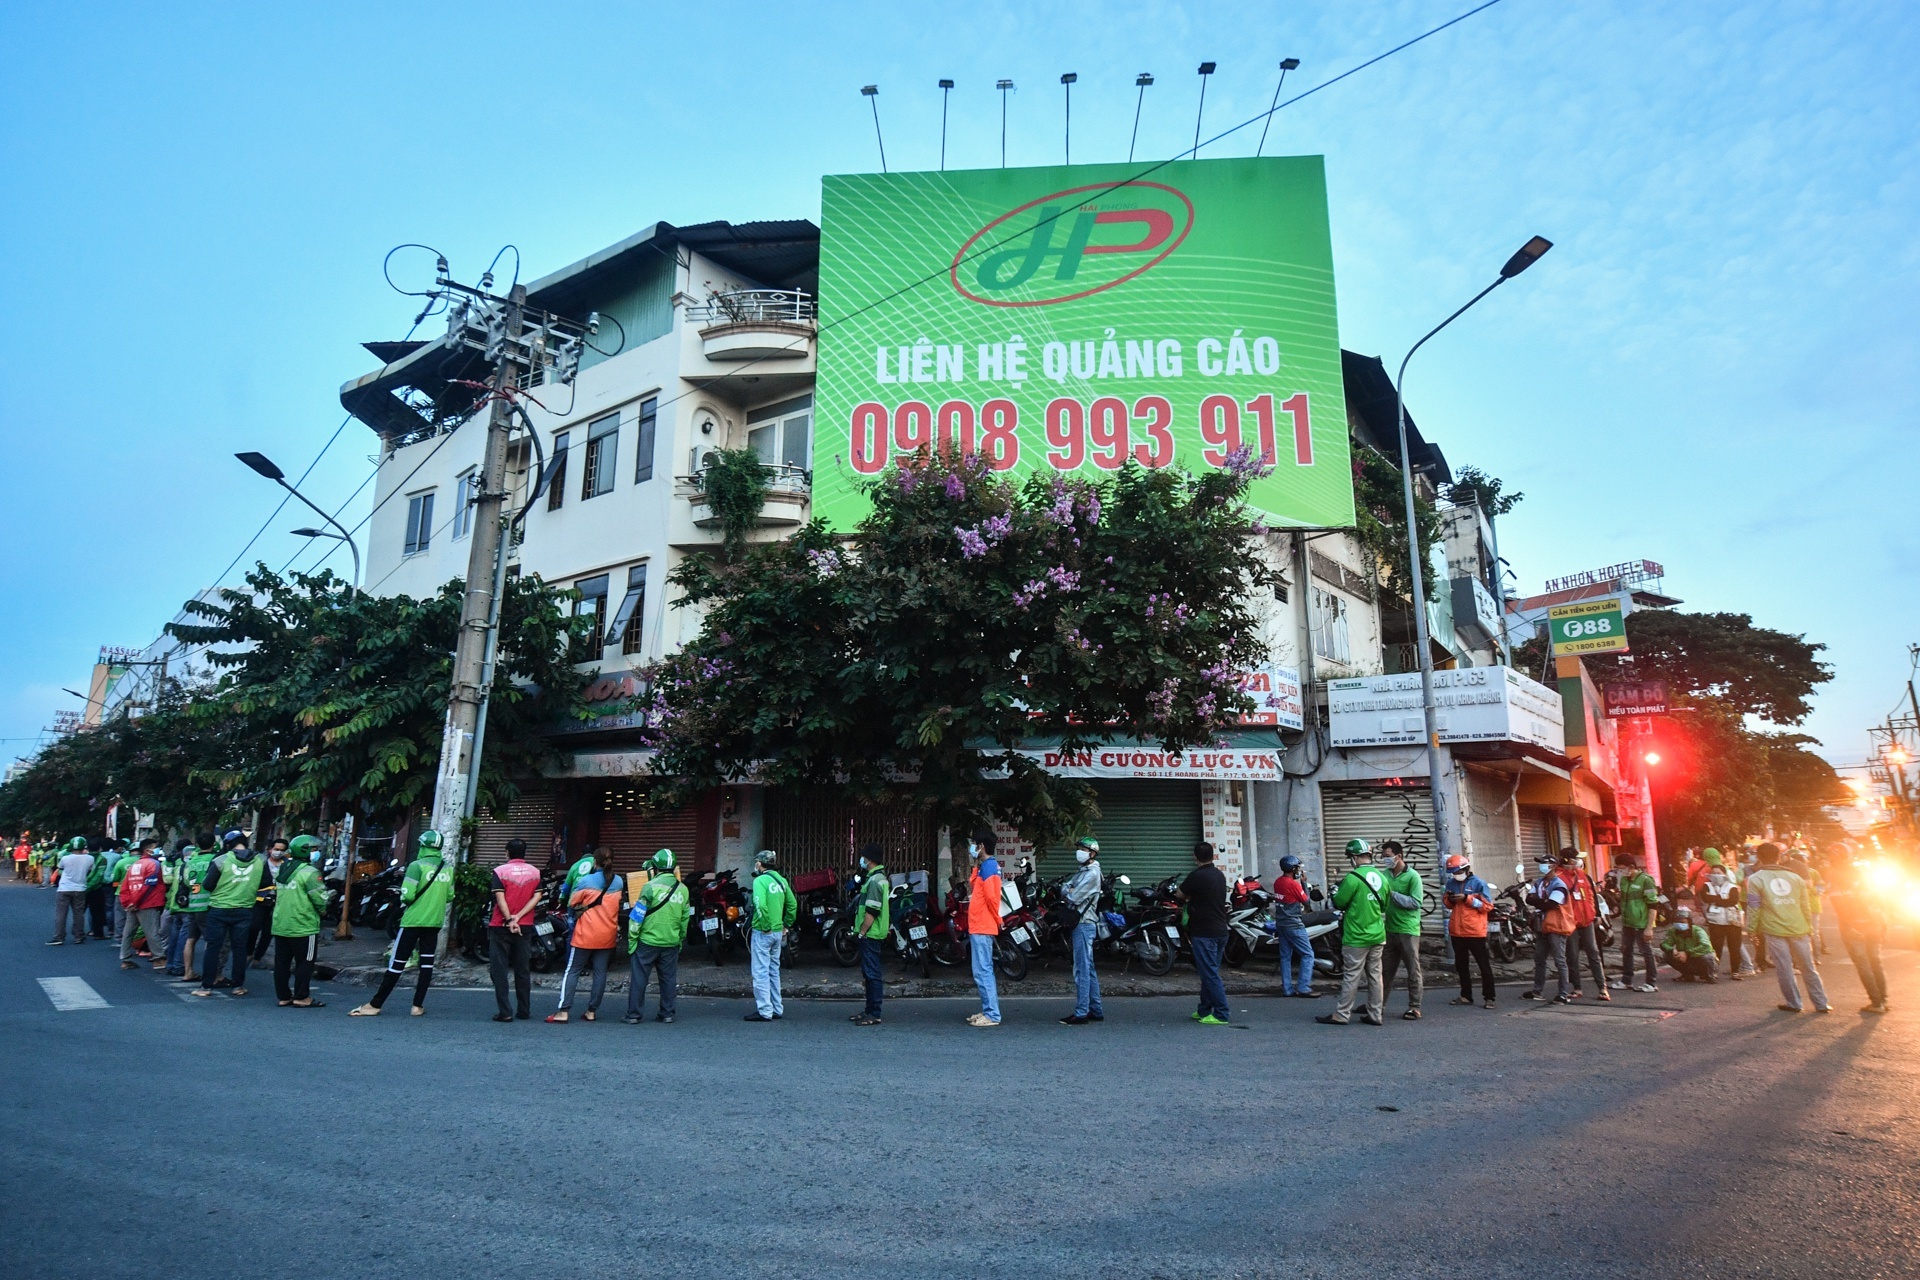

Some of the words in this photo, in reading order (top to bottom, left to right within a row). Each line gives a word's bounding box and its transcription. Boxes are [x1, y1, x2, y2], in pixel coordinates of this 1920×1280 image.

[877, 336, 964, 384] LIÊN
[978, 334, 1028, 389] HỆ
[1043, 327, 1183, 384] QUẢNG
[1197, 328, 1280, 377] CÁO
[849, 399, 1019, 475] 0908
[1045, 394, 1175, 471] 993
[1199, 392, 1315, 468] 911
[1545, 579, 1559, 592] AN
[1599, 561, 1637, 581] HOTEL
[1553, 608, 1568, 617] CẦN
[1587, 604, 1601, 613] GỌI
[1576, 642, 1595, 651] 1800
[1597, 640, 1616, 648] 6388
[1372, 680, 1392, 693] NHÀ
[1432, 674, 1450, 688] HỐI
[1453, 668, 1489, 687] P.69
[1646, 704, 1666, 713] PHÁT
[1100, 750, 1182, 768] CƯỜNG
[1189, 753, 1276, 771] LỰC.VN
